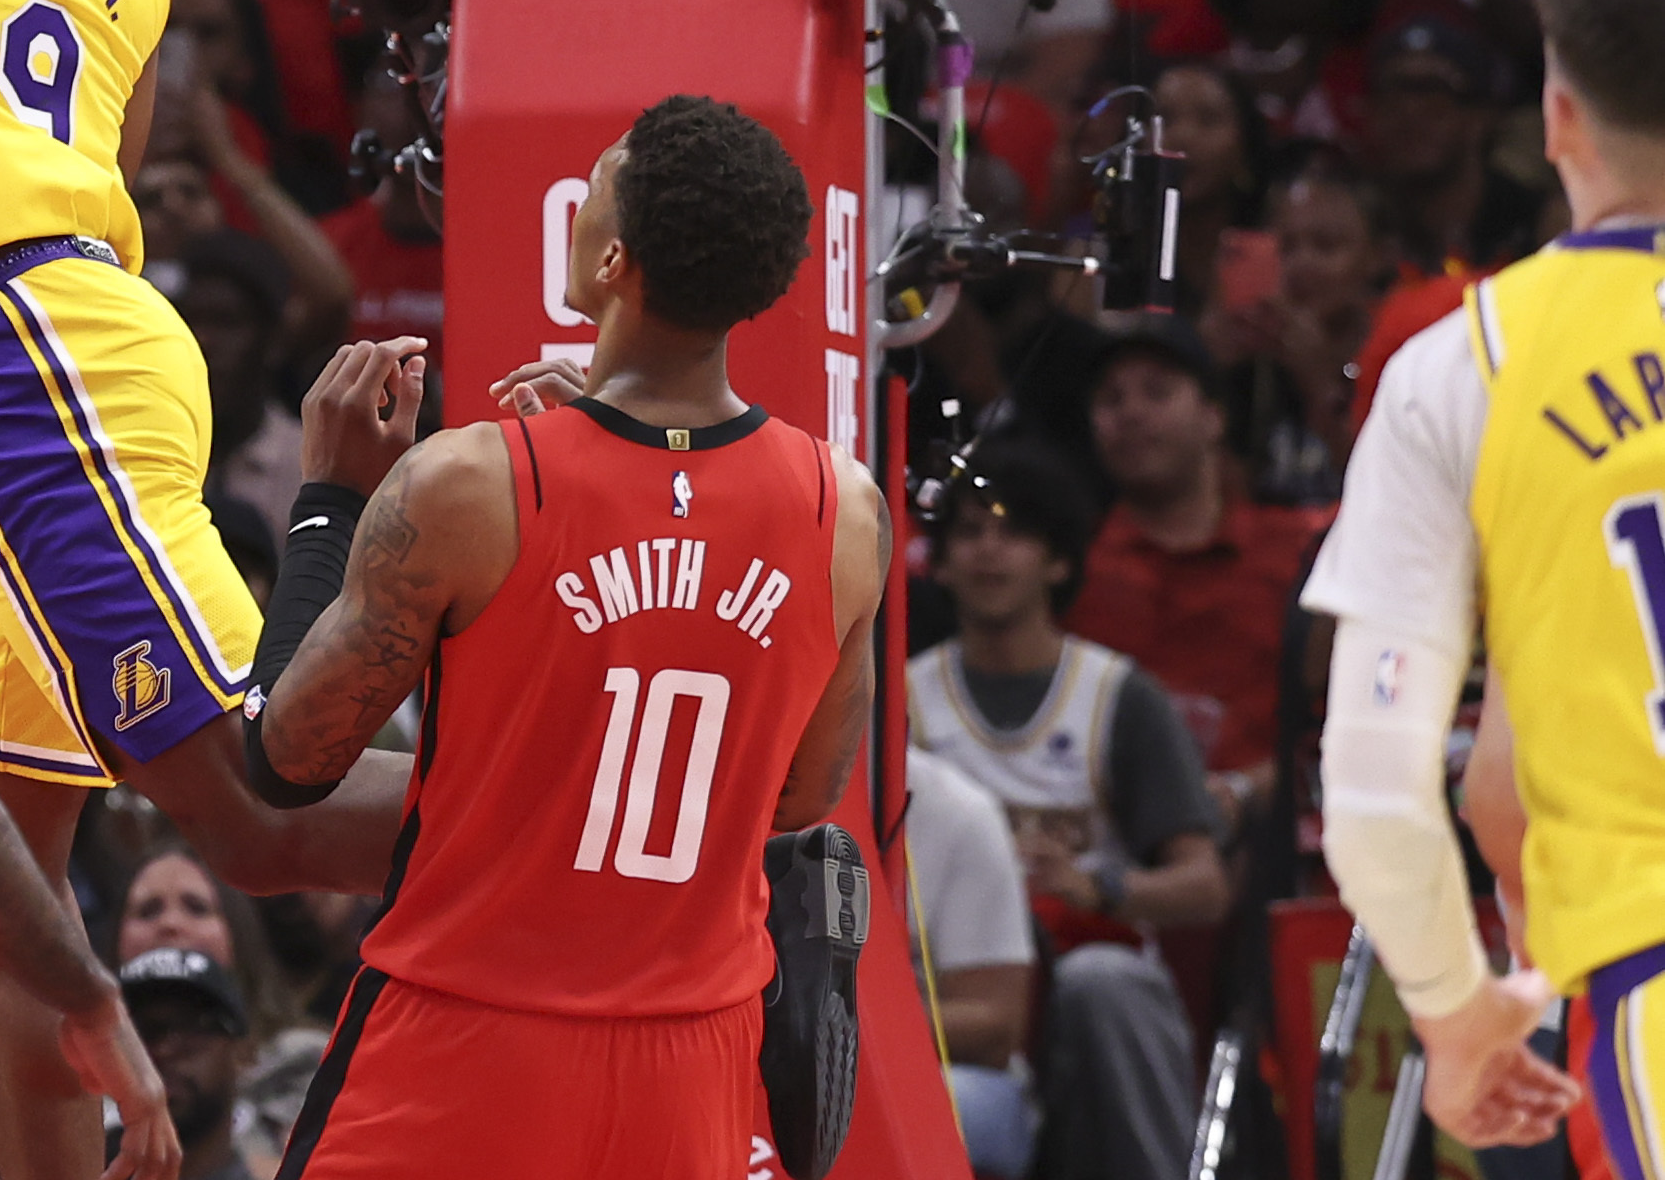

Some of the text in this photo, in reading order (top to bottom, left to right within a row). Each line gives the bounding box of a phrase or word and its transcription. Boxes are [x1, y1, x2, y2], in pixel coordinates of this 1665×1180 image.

[554, 537, 792, 650] SMITH JR.
[573, 666, 732, 884] 10
